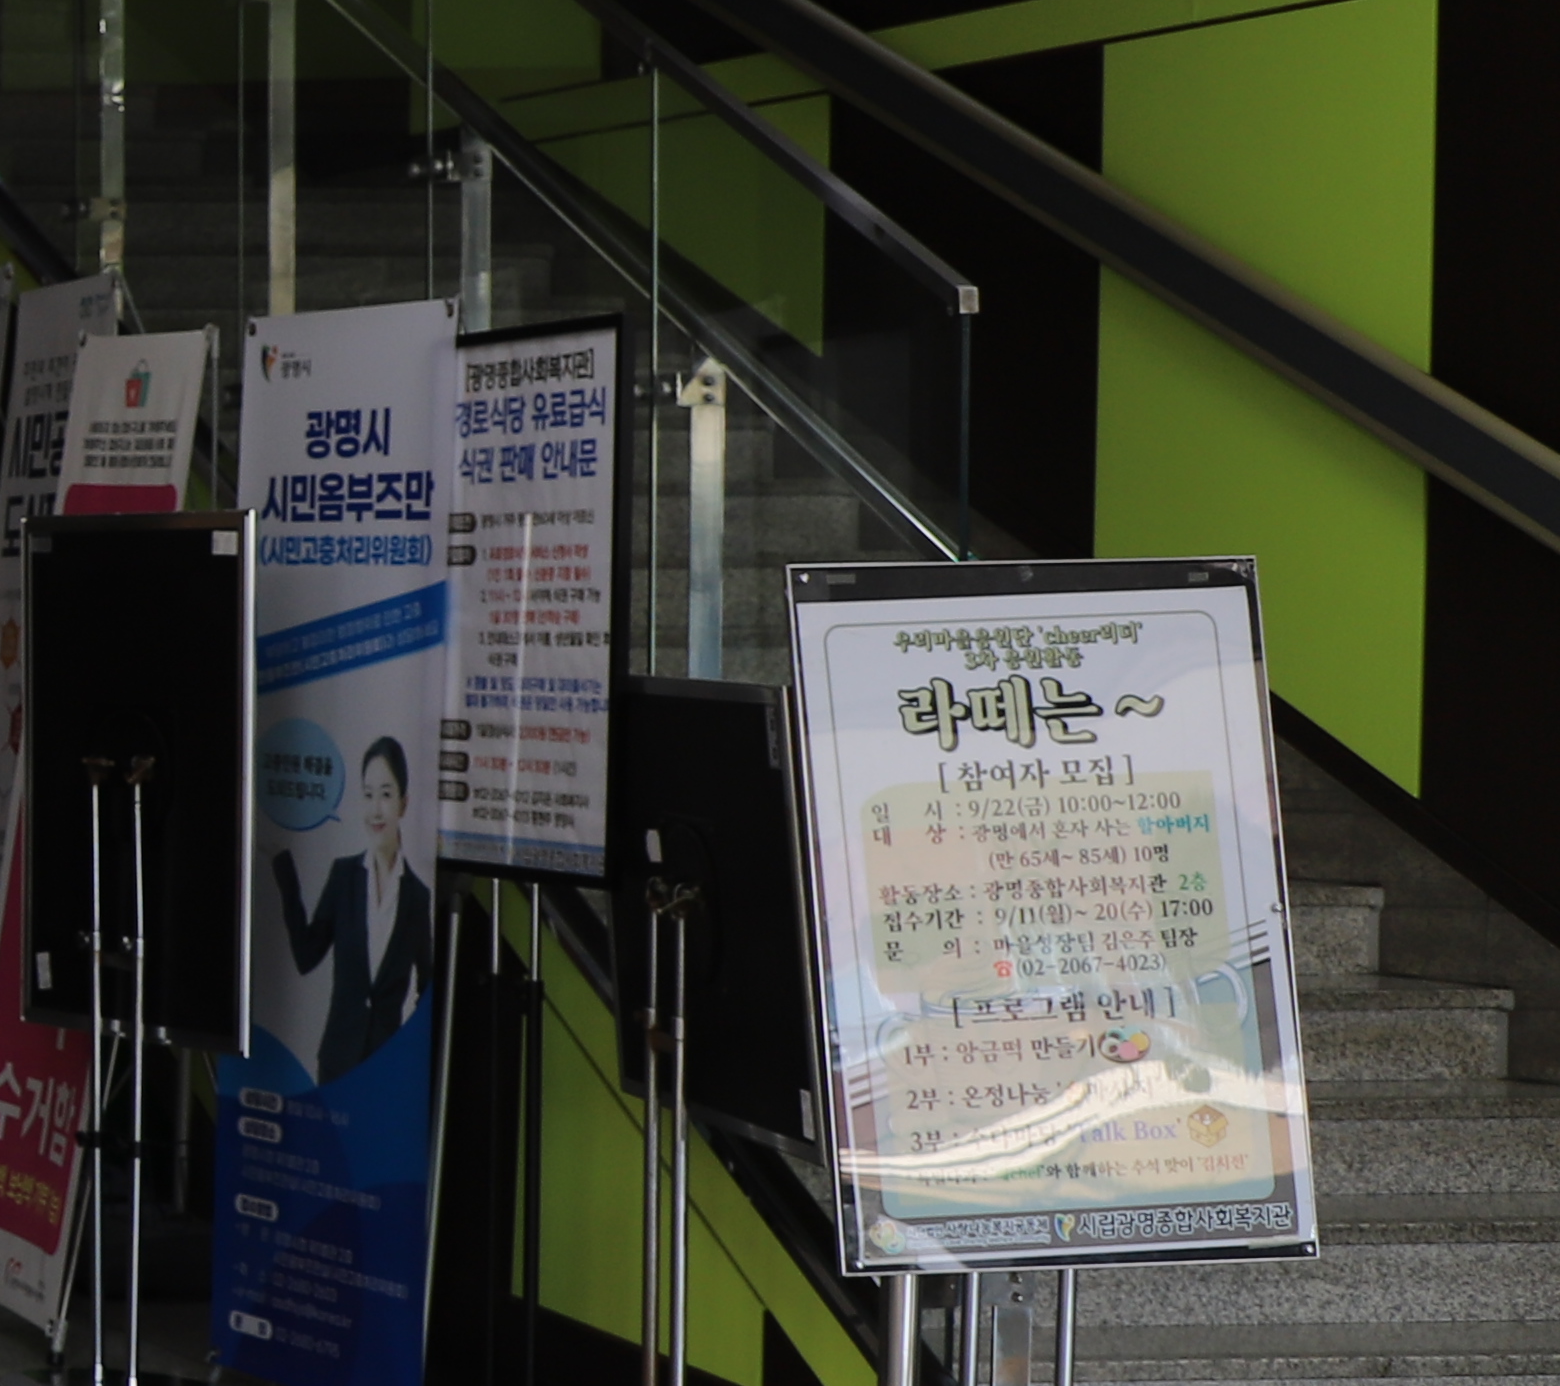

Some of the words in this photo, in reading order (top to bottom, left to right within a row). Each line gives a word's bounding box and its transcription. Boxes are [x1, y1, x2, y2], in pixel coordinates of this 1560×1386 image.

[455, 396, 526, 439] 경로식당
[532, 387, 607, 431] 유료급식
[306, 407, 392, 459] 광명시
[459, 447, 494, 485] 식권
[541, 439, 598, 480] 안내문
[262, 471, 435, 522] 시민옴부즈만
[260, 535, 433, 565] (시민고충처리위원회)
[958, 758, 1049, 792] 참여자
[1059, 755, 1115, 786] 모집
[969, 796, 1051, 820] 9/22(금)
[1052, 818, 1090, 839] 혼자
[1095, 817, 1131, 838] 사는
[1137, 814, 1211, 835] 할아버지
[1178, 873, 1207, 892] 2층
[971, 992, 1086, 1024] 프로그램
[1098, 989, 1156, 1017] 안내
[1076, 1203, 1292, 1236] 시립광명종합사회복지관
